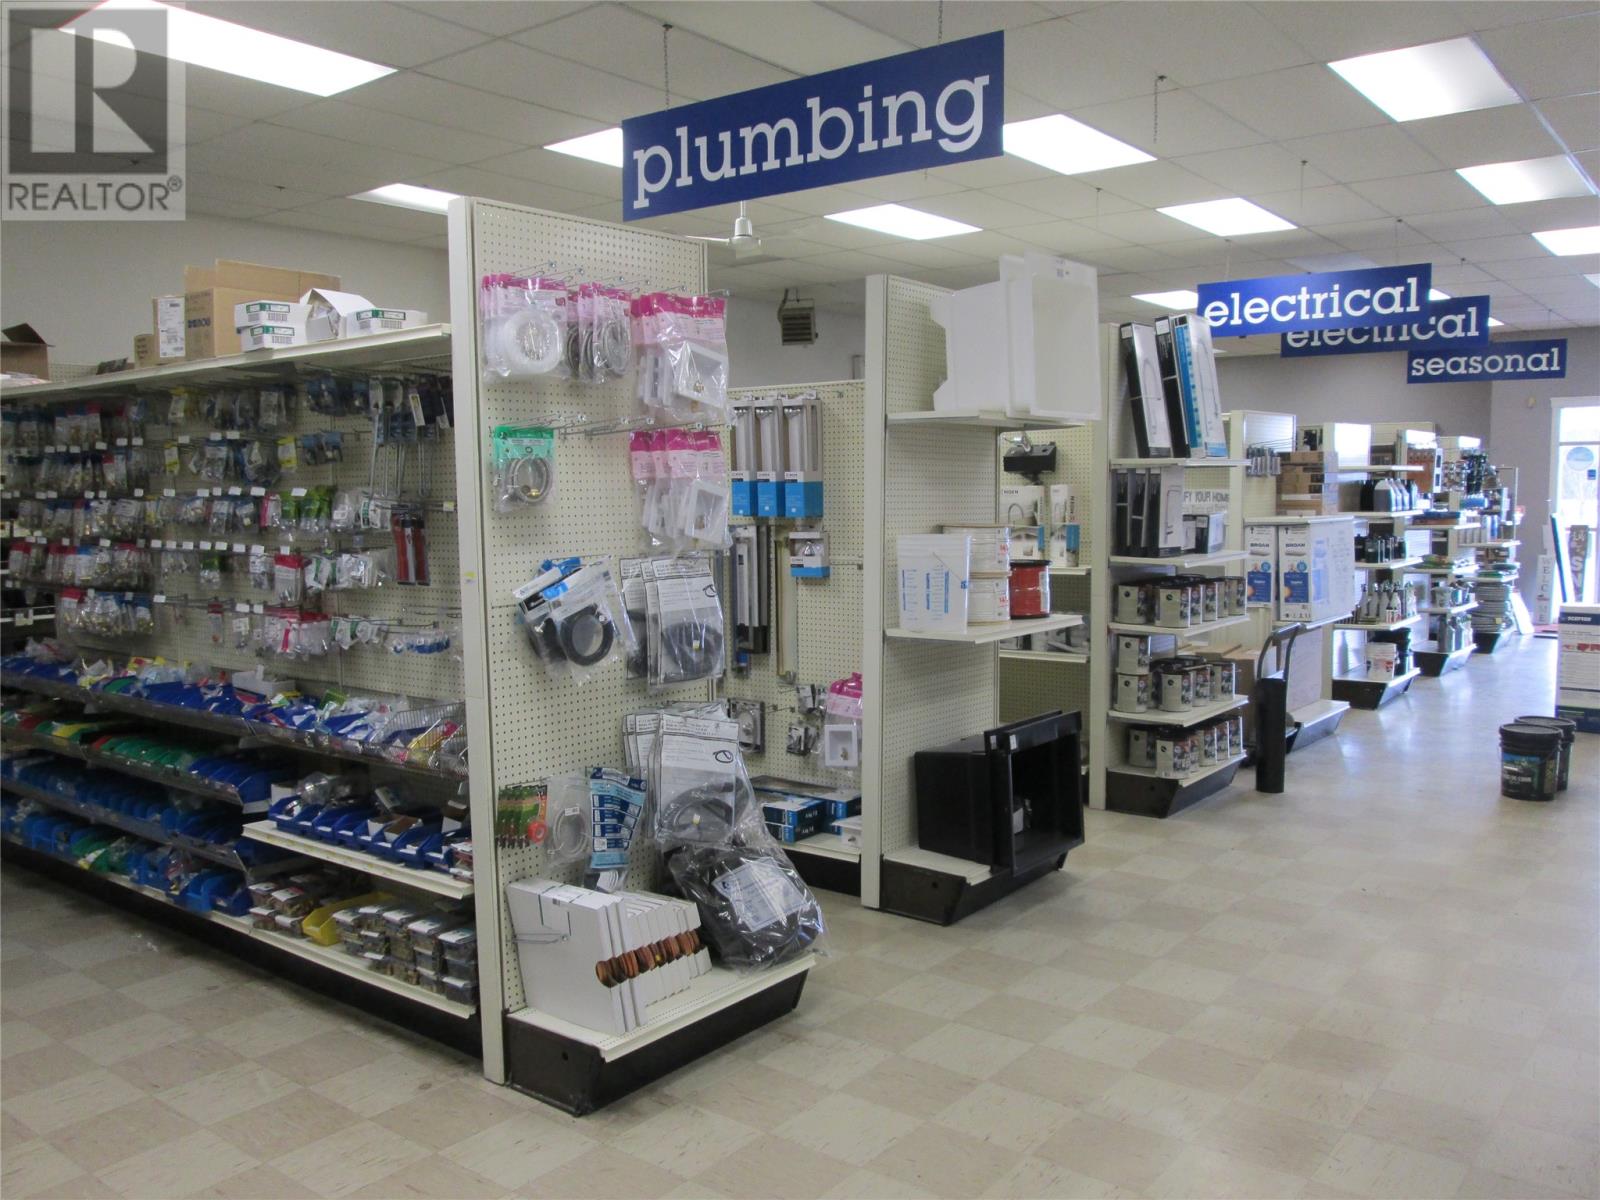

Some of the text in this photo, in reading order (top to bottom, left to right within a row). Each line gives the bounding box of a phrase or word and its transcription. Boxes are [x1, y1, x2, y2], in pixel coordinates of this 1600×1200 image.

[633, 74, 990, 210] plumbing
[1203, 277, 1420, 329] electrical
[1410, 347, 1561, 377] seasonal
